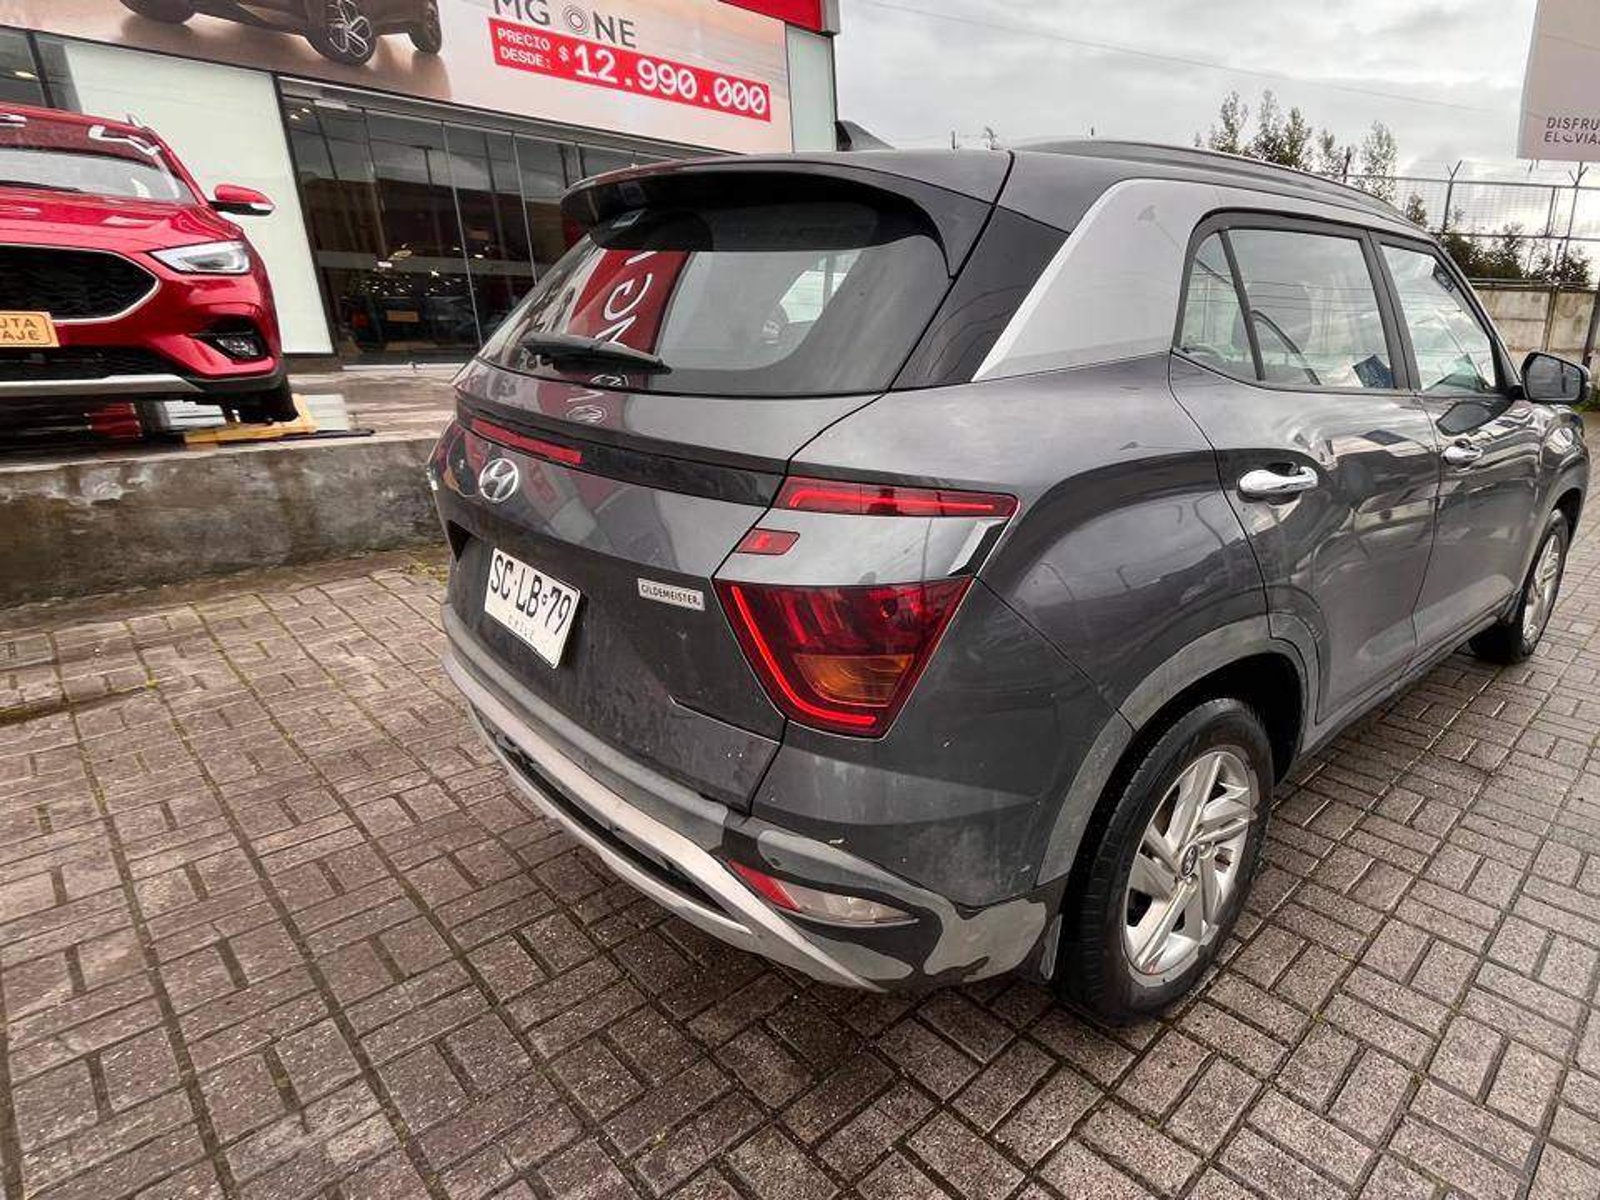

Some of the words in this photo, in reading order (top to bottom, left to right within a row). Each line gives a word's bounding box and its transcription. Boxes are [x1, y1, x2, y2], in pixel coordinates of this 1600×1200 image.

[494, 0, 550, 26] MG
[562, 4, 637, 49] ONE
[497, 27, 551, 51] PRECIO
[500, 45, 553, 70] DESDE:
[574, 44, 766, 114] 12.990.000
[1546, 117, 1600, 131] DISFRU
[1544, 131, 1561, 143] EL
[1575, 132, 1600, 145] VIA
